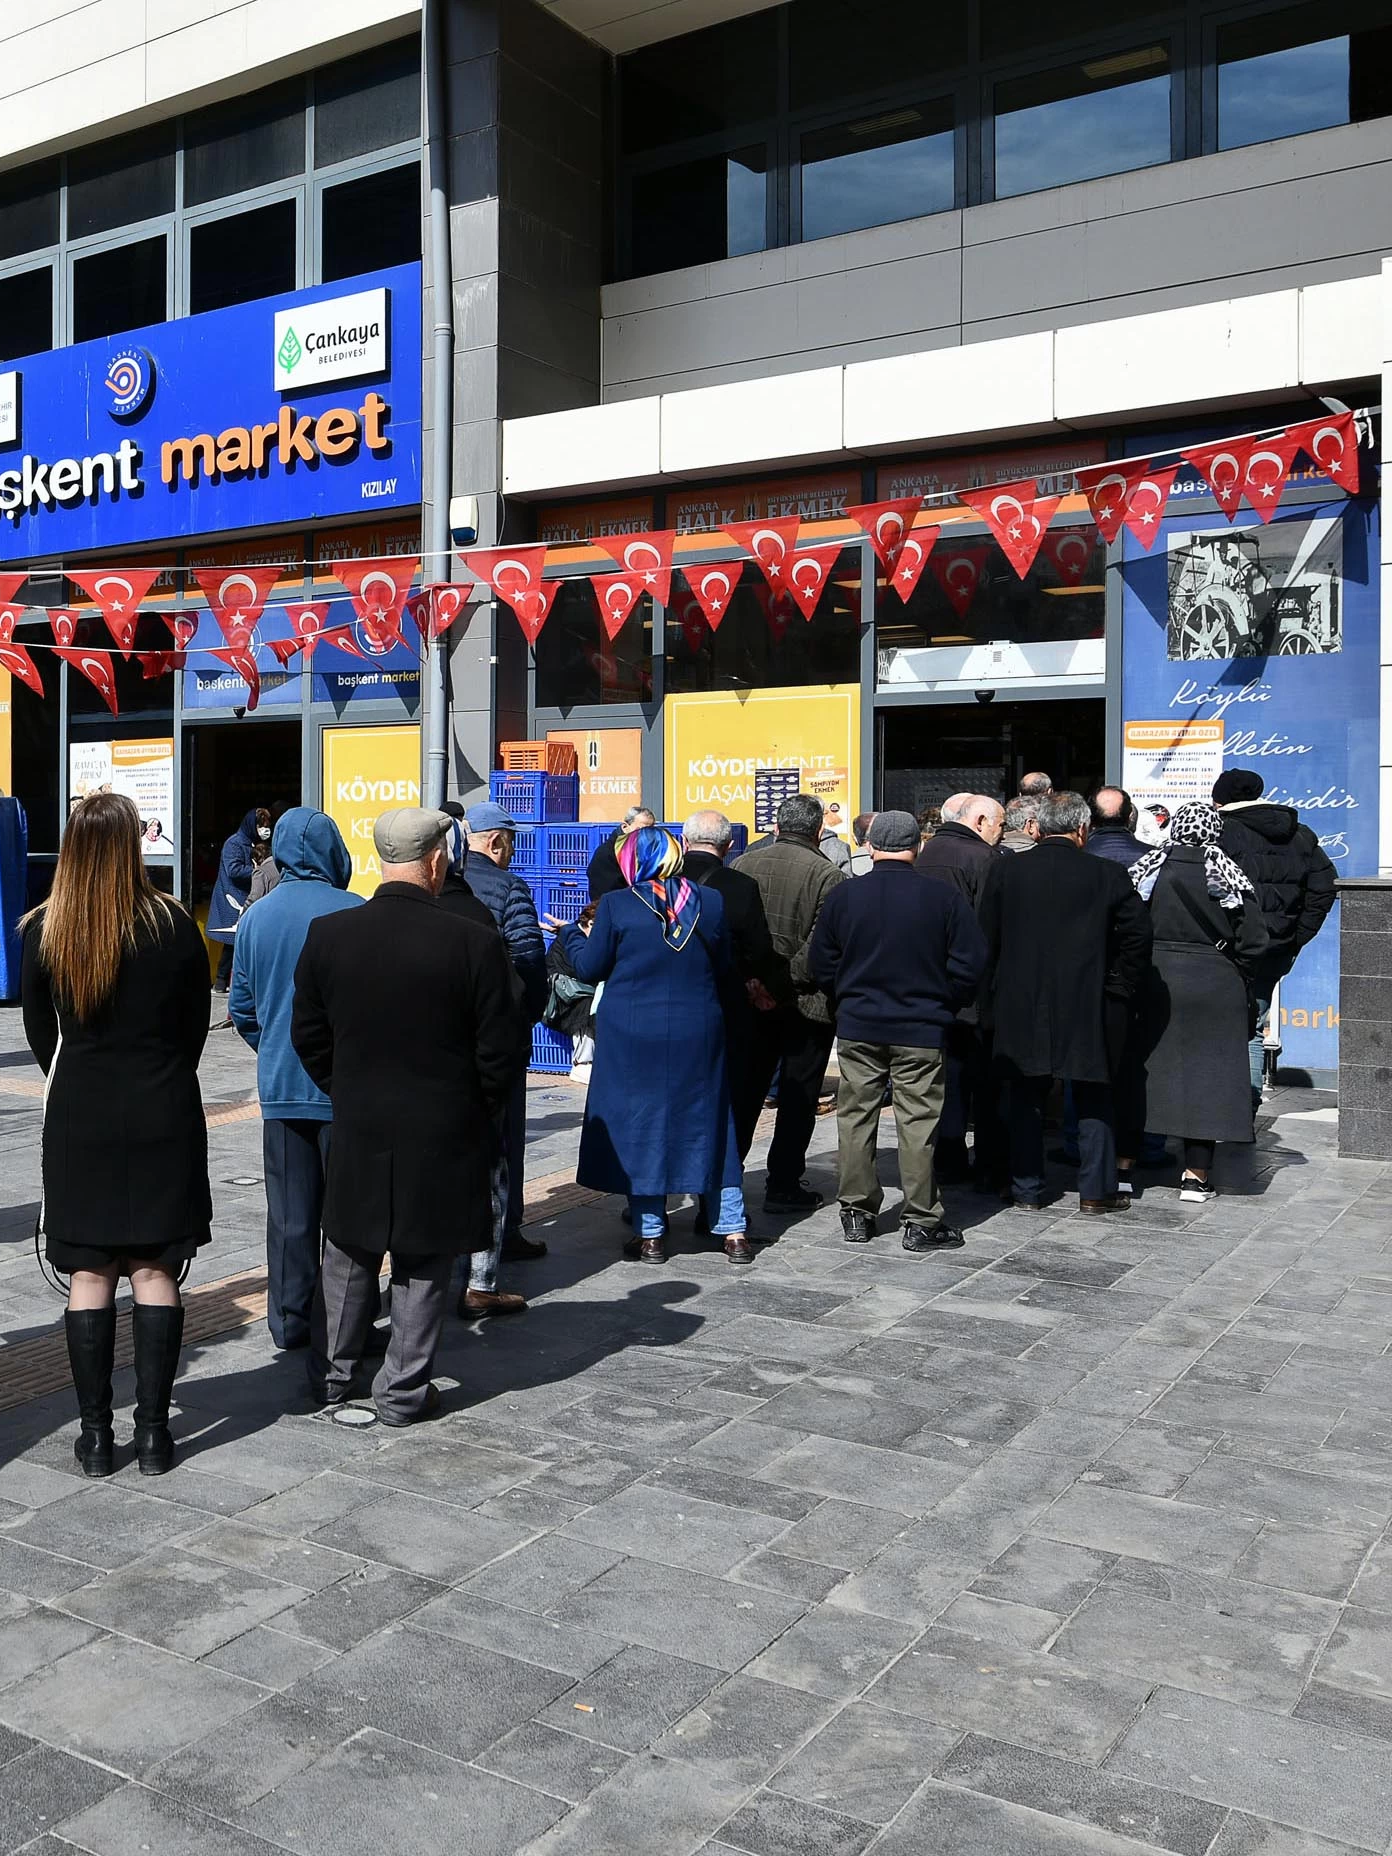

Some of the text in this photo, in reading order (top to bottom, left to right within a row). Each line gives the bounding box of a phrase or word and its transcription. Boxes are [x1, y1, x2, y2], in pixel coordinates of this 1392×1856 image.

[305, 322, 380, 354] Çankaya
[161, 392, 388, 484] market
[361, 478, 398, 499] KIZILAY
[891, 474, 940, 489] ANKARA
[676, 509, 736, 536] HALK
[767, 495, 848, 520] EKMEK
[678, 501, 720, 515] ANKARA
[599, 520, 649, 538] EKMEK
[319, 540, 351, 550] ANKARA
[196, 677, 244, 691] başkent
[338, 671, 420, 687] başkent market
[1222, 730, 1313, 756] lletin
[688, 754, 772, 777] KÖYDEN
[336, 775, 420, 802] KÖYDEN
[590, 780, 638, 795] EKMEK
